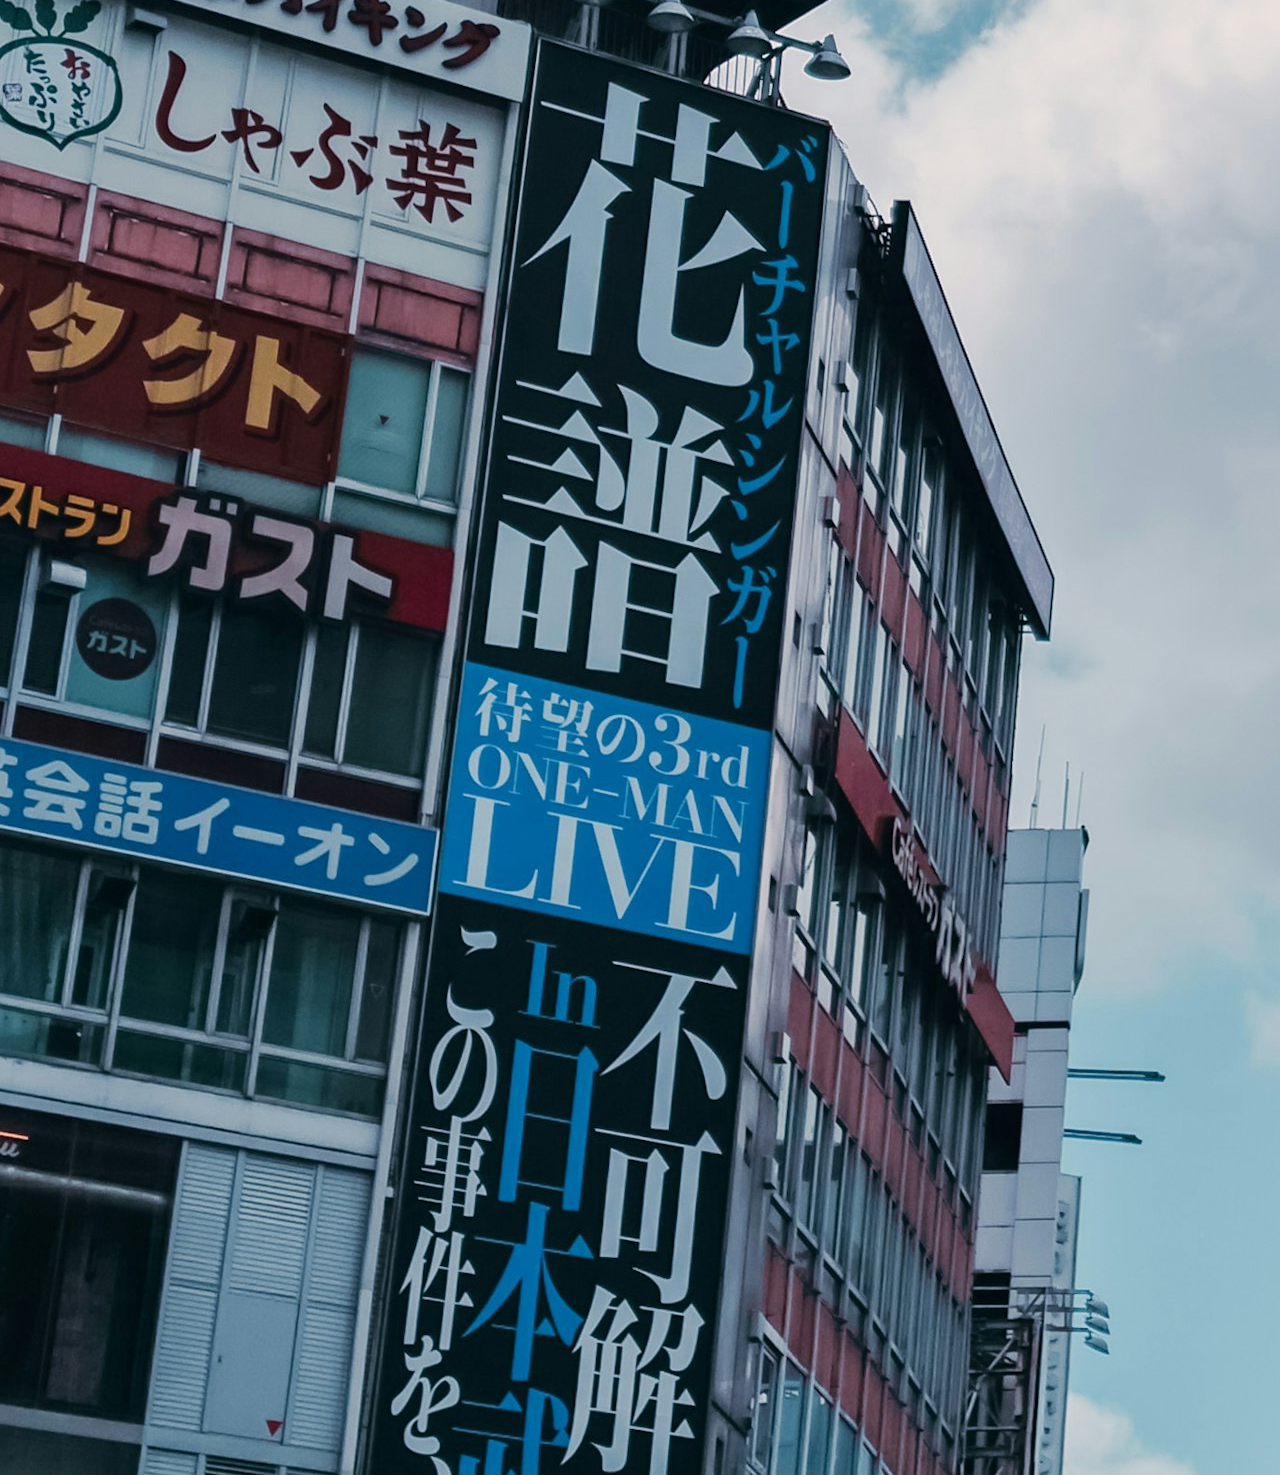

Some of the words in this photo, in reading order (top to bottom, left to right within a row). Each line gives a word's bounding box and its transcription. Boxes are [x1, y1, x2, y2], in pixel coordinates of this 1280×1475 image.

[156, 51, 478, 224] しゃぶ葉
[484, 81, 768, 689] 花譜
[719, 135, 818, 710] バーチャルシンガー
[146, 495, 394, 621] ガスト
[87, 631, 147, 659] ガスト
[467, 742, 747, 843] ONE-MAN
[475, 675, 749, 790] 待望の3rd
[453, 792, 741, 942] LIVE
